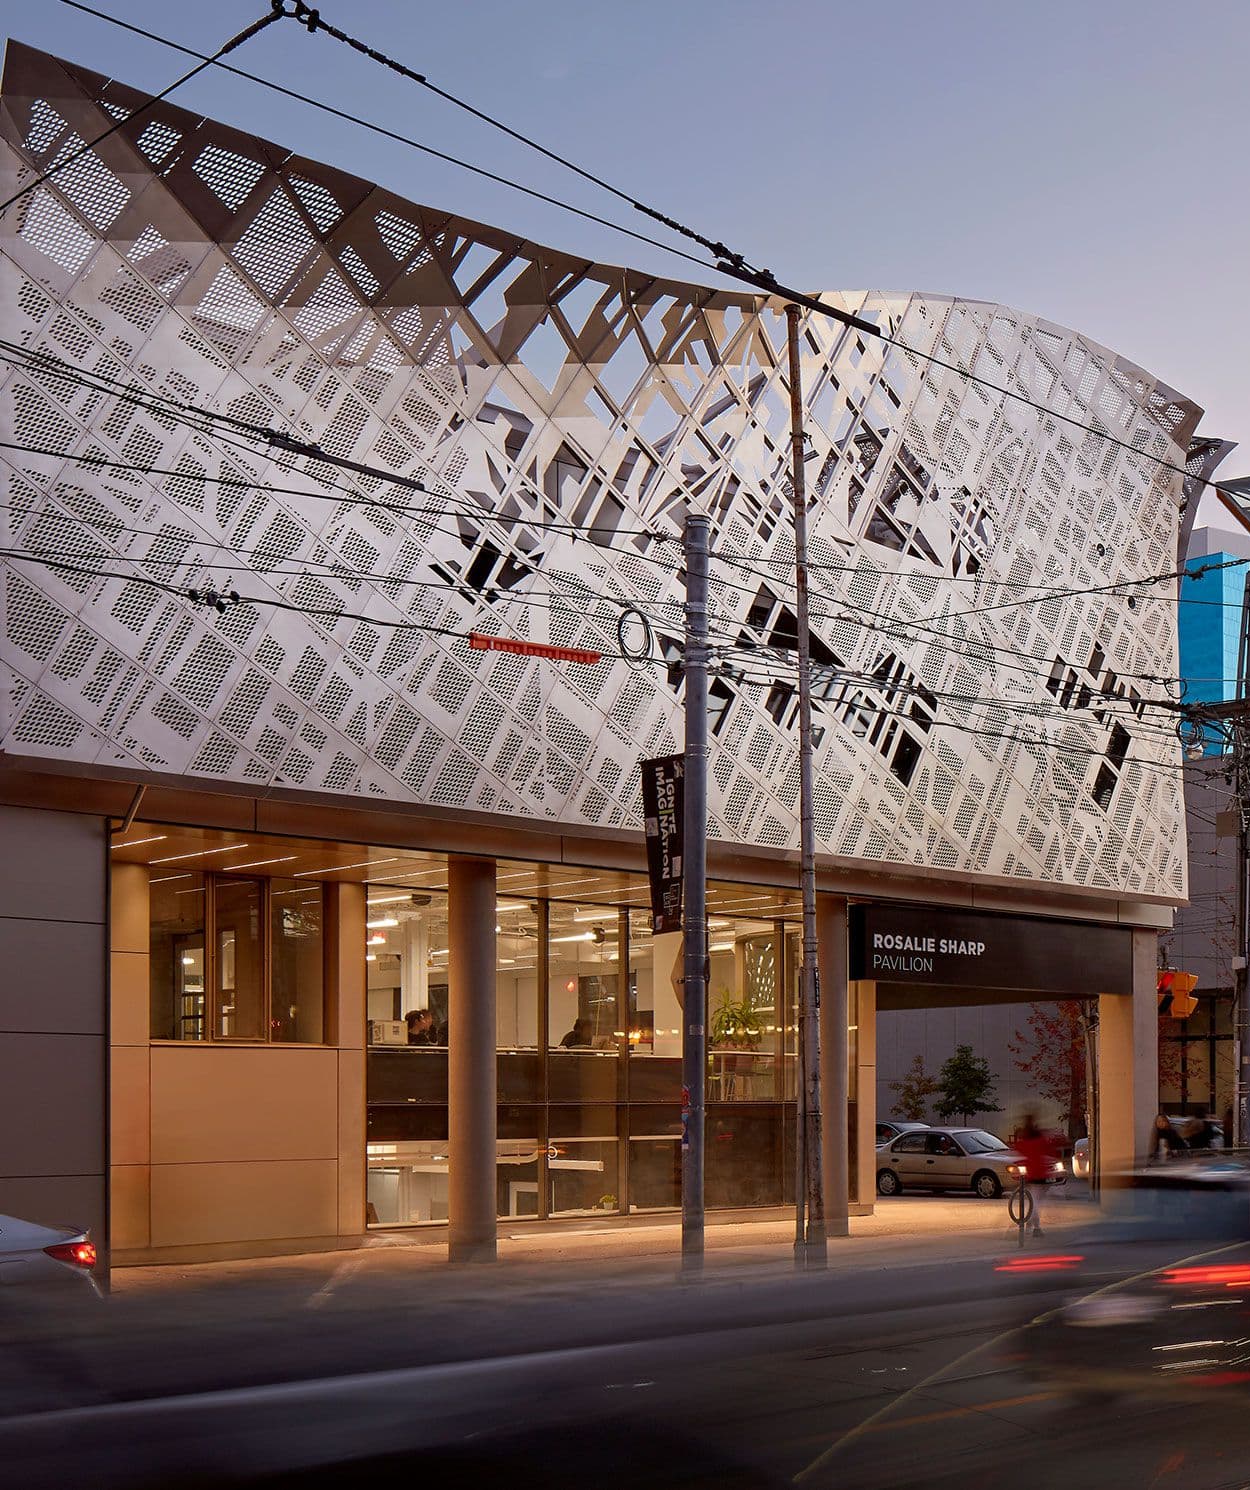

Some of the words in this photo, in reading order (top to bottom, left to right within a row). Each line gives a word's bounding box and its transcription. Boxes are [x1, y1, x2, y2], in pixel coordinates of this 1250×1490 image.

[655, 766, 670, 880] IMAGINATION
[665, 778, 677, 834] IGNITE
[873, 933, 936, 953] ROSALIE
[939, 939, 986, 956] SHARP
[873, 954, 933, 972] PAVILION
